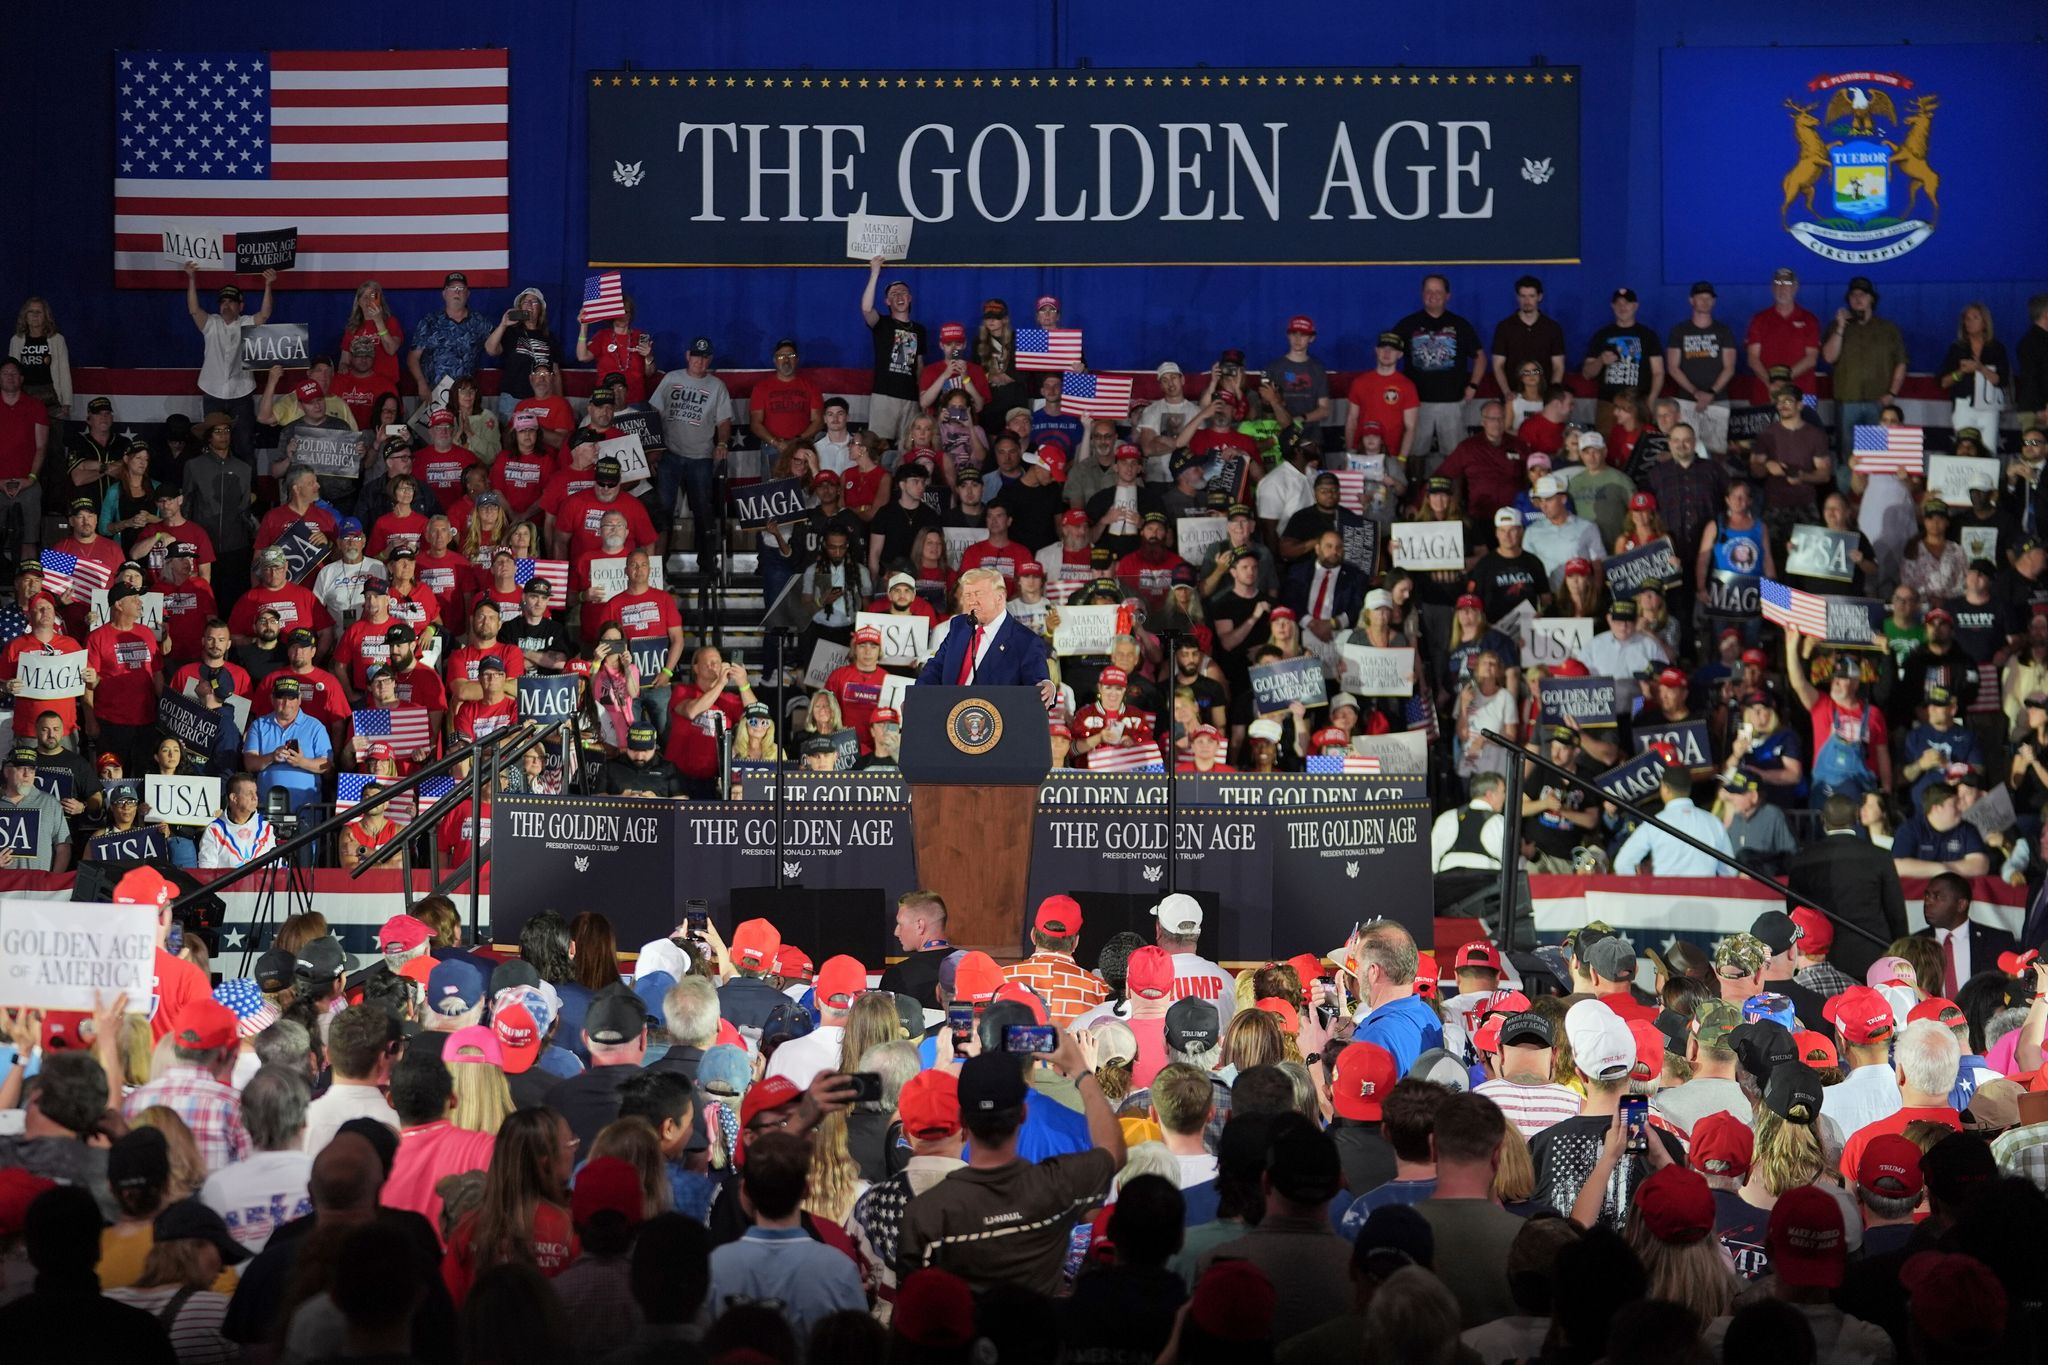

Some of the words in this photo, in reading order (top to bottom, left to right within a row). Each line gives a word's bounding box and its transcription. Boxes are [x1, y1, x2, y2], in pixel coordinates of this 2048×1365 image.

[1834, 152, 1888, 165] TUEBOR
[678, 121, 868, 222] THE
[898, 122, 1288, 223] GOLDEN
[1309, 120, 1494, 220] AGE
[864, 223, 898, 234] MAKING
[165, 232, 222, 260] MAGA
[237, 241, 278, 255] GOLDEN
[279, 238, 296, 252] AGE
[861, 233, 899, 244] AMERICA
[851, 242, 879, 254] GREAT
[251, 251, 292, 266] AMERICA
[243, 336, 309, 361] MAGA
[670, 389, 709, 406] GULF
[670, 403, 704, 415] AMERICA
[682, 411, 703, 421] 2025
[296, 438, 338, 454] GOLDEN
[309, 453, 355, 467] AMERICA
[736, 489, 804, 522] MAGA
[1398, 536, 1461, 561] MAGA
[1496, 572, 1534, 587] MAGA
[1530, 628, 1582, 660] USA
[21, 664, 84, 690] MAGA
[1252, 669, 1299, 693] GOLDEN
[1300, 666, 1323, 684] AGE
[519, 686, 578, 716] MAGA
[1271, 683, 1321, 704] AMERICA
[1541, 688, 1589, 705] GOLDEN
[1590, 687, 1613, 702] AGE
[160, 697, 198, 727] GOLDEN
[196, 718, 218, 738] AGE
[1558, 701, 1612, 717] AMERICA
[167, 718, 209, 748] AMERICA
[1602, 761, 1665, 803] MAGA
[154, 784, 214, 817] USA
[510, 811, 545, 838] THE
[549, 813, 620, 842] GOLDEN
[623, 816, 658, 844] AGE
[690, 819, 738, 845] THE
[744, 819, 842, 846] GOLDEN
[847, 819, 894, 846] AGE
[1288, 821, 1319, 849] THE
[1322, 818, 1384, 848] GOLDEN
[1387, 816, 1416, 844] AGE
[1050, 822, 1099, 849] THE
[1105, 822, 1204, 850] GOLDEN
[1208, 823, 1256, 851] AGE
[574, 843, 596, 851] DONALD
[1320, 850, 1345, 858] PRESIDENT
[1345, 848, 1365, 857] DONALD
[1369, 847, 1385, 855] TRUMP
[1102, 852, 1141, 860] PRESIDENT
[4, 929, 108, 960] GOLDEN
[110, 932, 151, 961] AGE
[1467, 943, 1490, 953] MAGA
[37, 961, 142, 988] AMERICA
[1505, 1013, 1520, 1026] MAKE
[1521, 1012, 1549, 1027] AMERICA
[1507, 1021, 1528, 1032] GREAT
[1528, 1022, 1548, 1033] AGAIN
[1866, 1013, 1888, 1025] TRUMP
[1770, 1054, 1793, 1062] TRUMP
[1793, 1092, 1817, 1102] TRUMP
[1879, 1164, 1906, 1174] TRUMP
[984, 1212, 1023, 1226] U-HAUL
